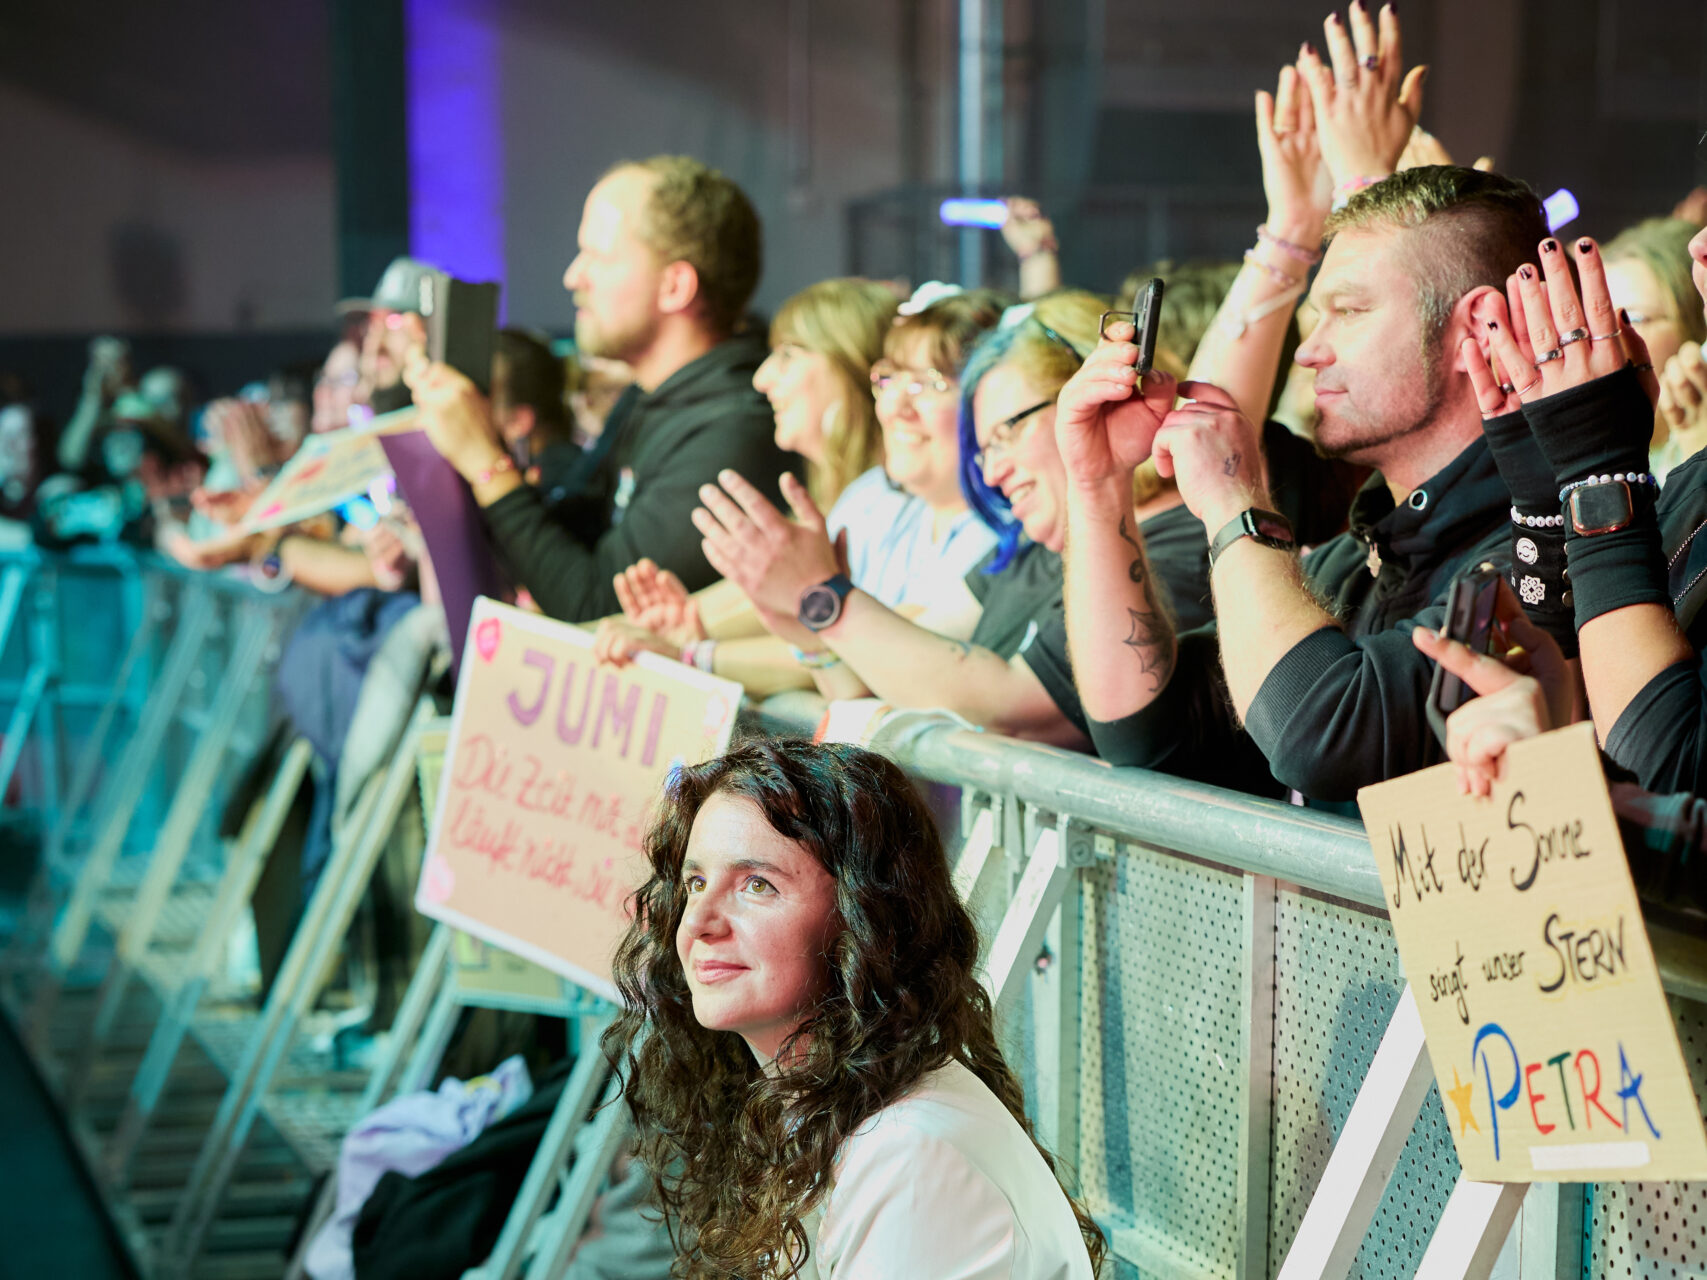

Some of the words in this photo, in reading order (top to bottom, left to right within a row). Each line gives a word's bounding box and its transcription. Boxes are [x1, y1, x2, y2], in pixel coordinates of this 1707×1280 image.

[507, 649, 668, 767] JUMI
[1389, 821, 1443, 909] Mit
[1457, 822, 1490, 892] der
[1507, 789, 1591, 892] Sonne
[1430, 940, 1470, 1026] singt
[1482, 950, 1526, 983] unser
[1538, 913, 1628, 993] STERN
[1472, 1022, 1661, 1162] PETRA
